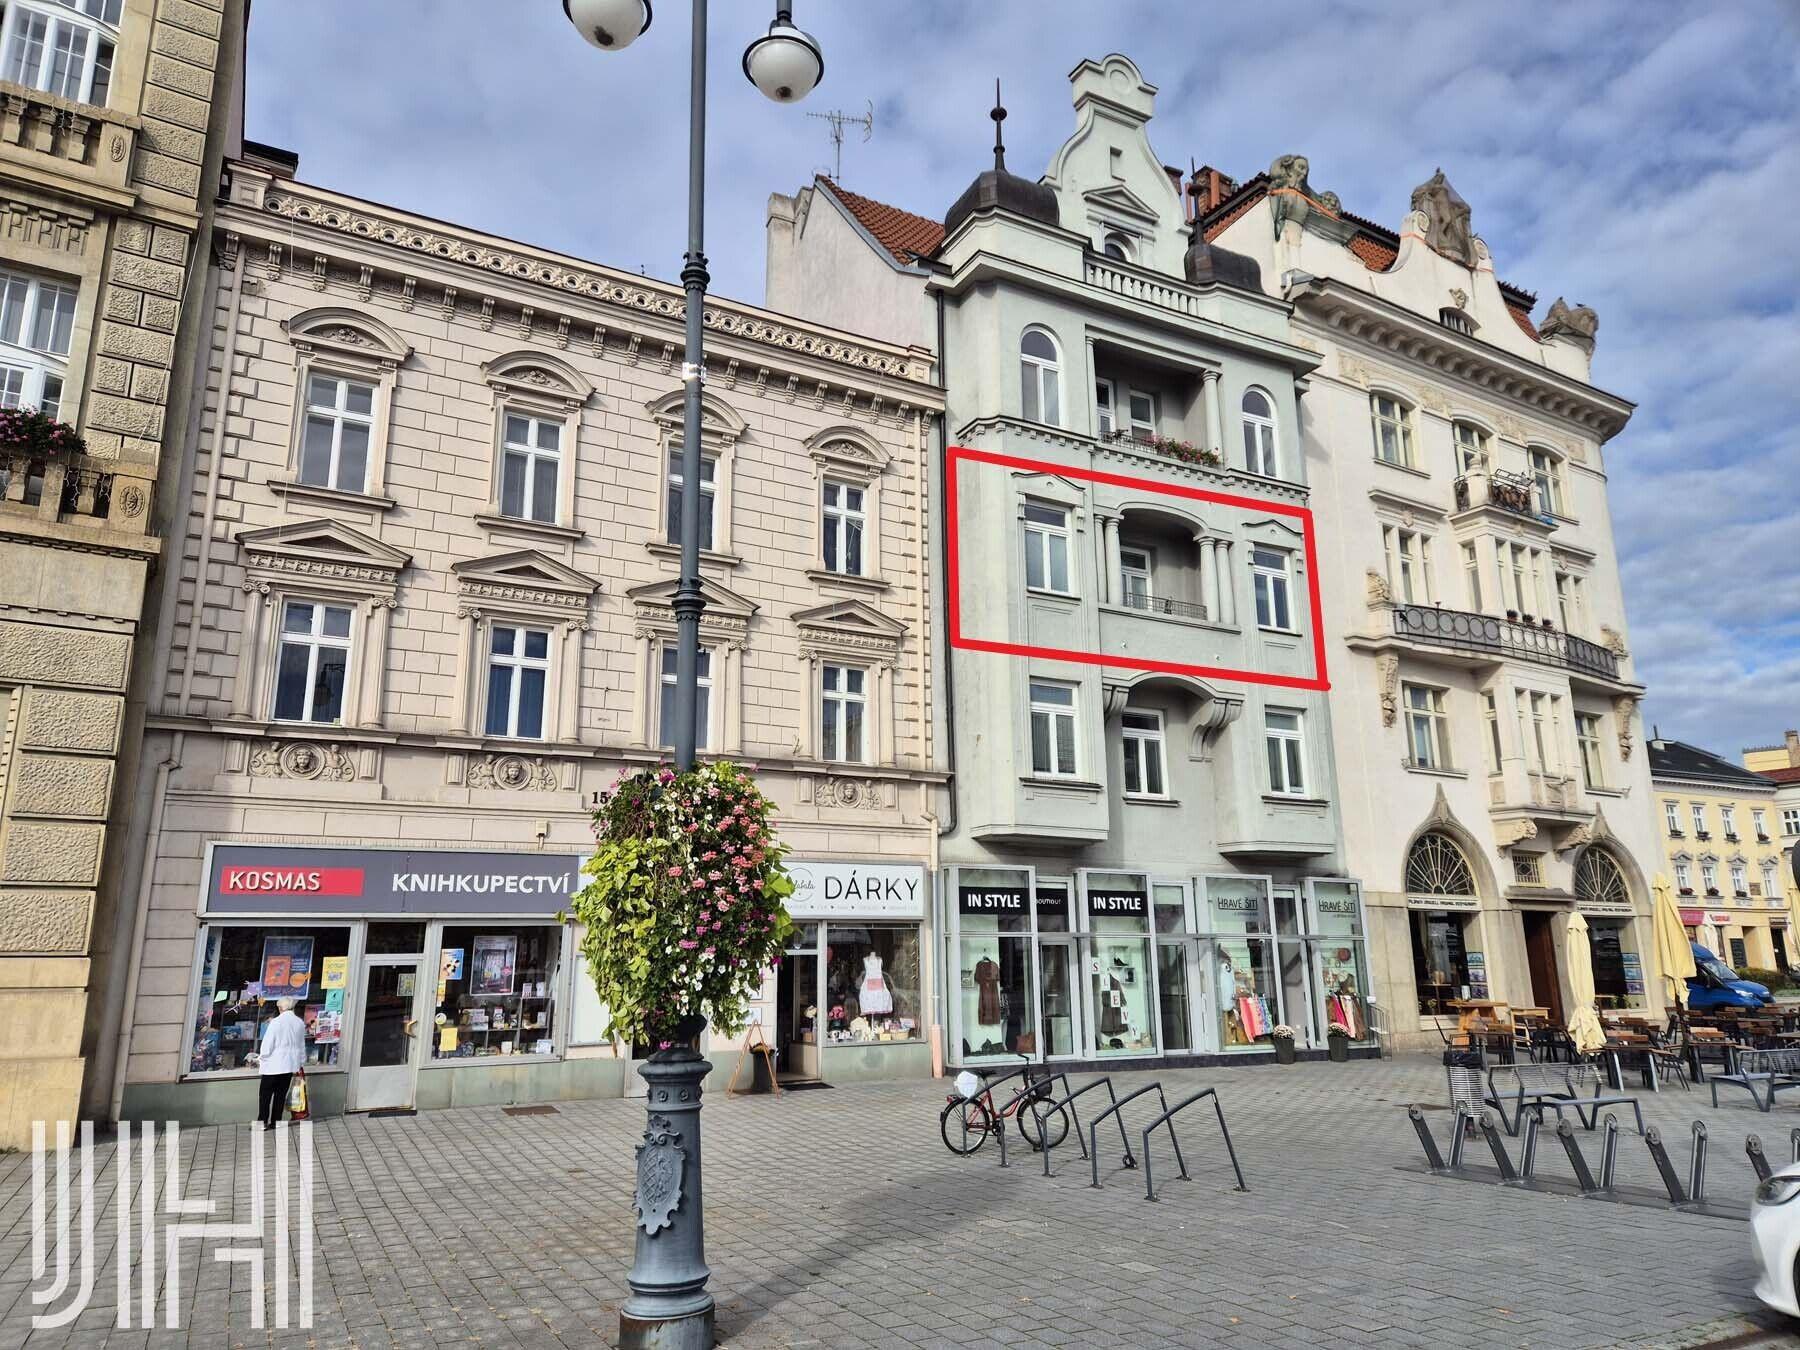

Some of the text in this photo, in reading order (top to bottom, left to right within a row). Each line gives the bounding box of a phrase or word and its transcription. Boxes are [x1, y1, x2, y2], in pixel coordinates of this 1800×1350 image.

[229, 871, 321, 891] KOSMAS
[392, 872, 570, 894] KNIHKUPECTVÍ
[825, 870, 919, 901] DÁRKY
[967, 894, 1021, 908] IN STYLE
[1093, 896, 1142, 910] IN STYLE
